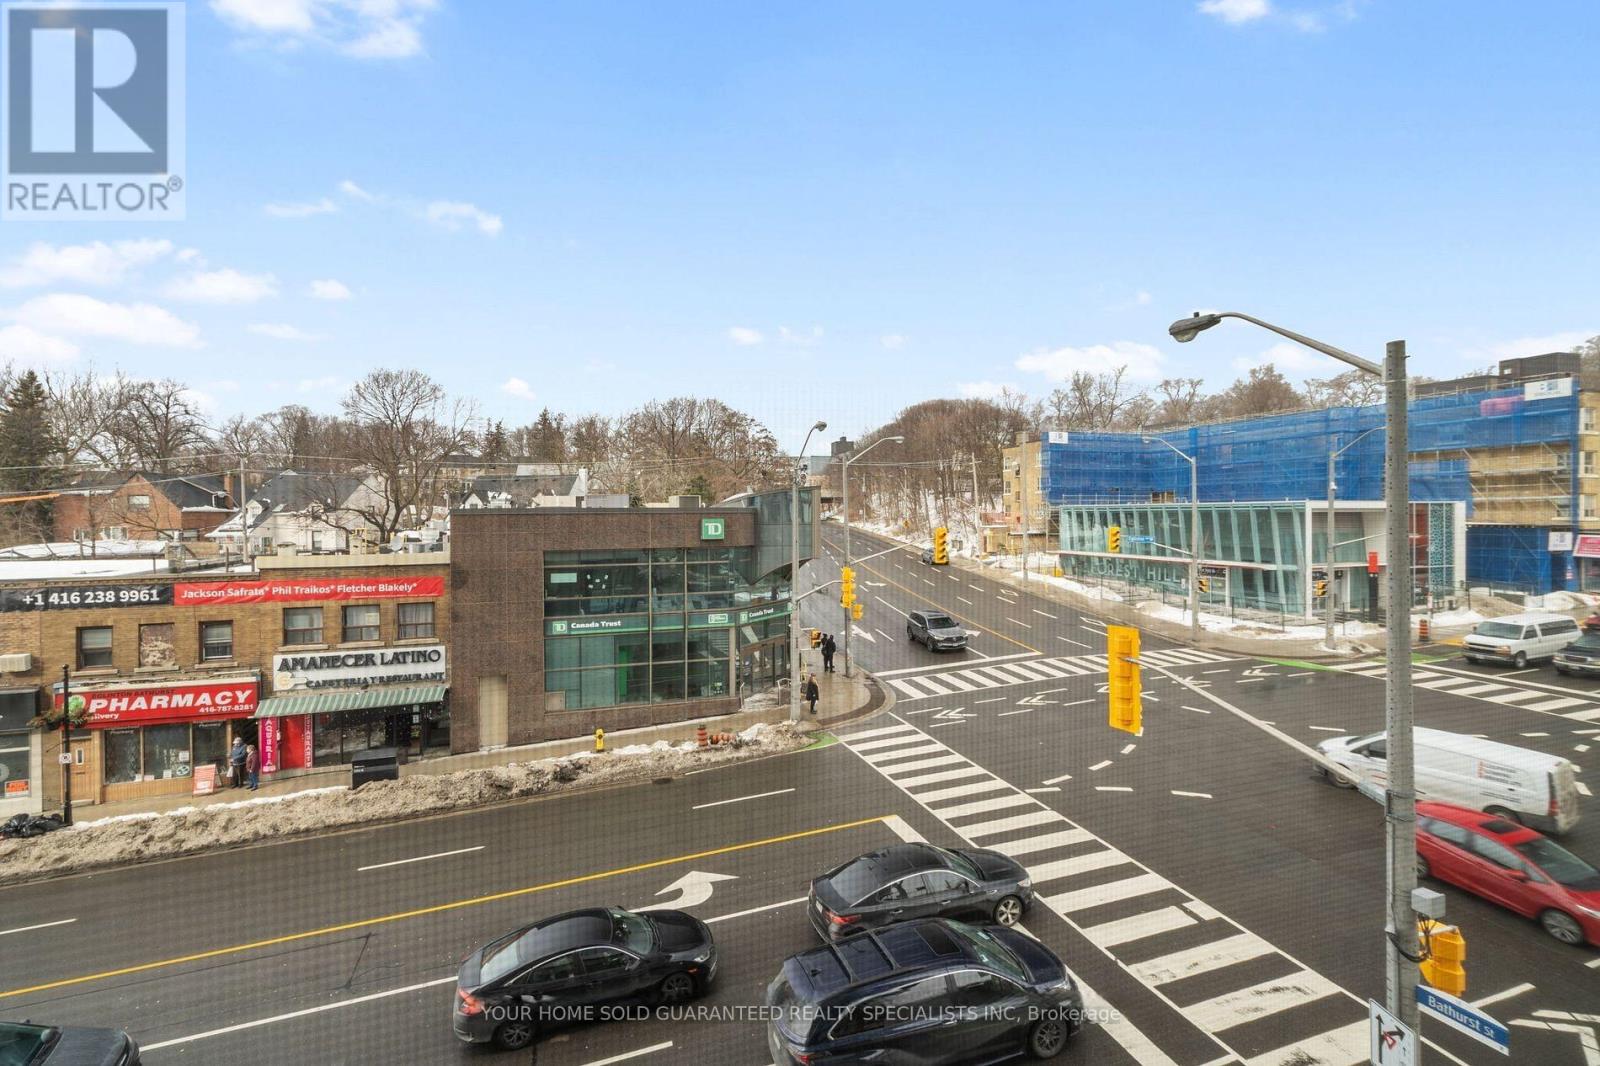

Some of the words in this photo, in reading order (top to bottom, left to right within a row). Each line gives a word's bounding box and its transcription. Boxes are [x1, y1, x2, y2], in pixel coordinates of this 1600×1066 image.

[704, 522, 722, 535] TD
[1147, 566, 1180, 583] HILL
[22, 593, 45, 606] +1
[48, 591, 80, 605] 416
[85, 590, 116, 604] 238
[119, 589, 160, 602] 9961
[181, 589, 225, 599] Jackson
[271, 586, 292, 595] Phil
[336, 583, 376, 594] Fletcher
[554, 623, 566, 632] TD
[570, 621, 600, 629] Canada
[600, 619, 622, 628] Trust
[277, 653, 377, 672] AMANECER
[380, 649, 441, 666] LATINO
[378, 672, 445, 683] RESTAURANT
[88, 689, 252, 713] PHARMACY
[91, 690, 133, 699] EGLINTON
[134, 688, 175, 697] BATHURST
[1427, 995, 1481, 1032] Bathurst
